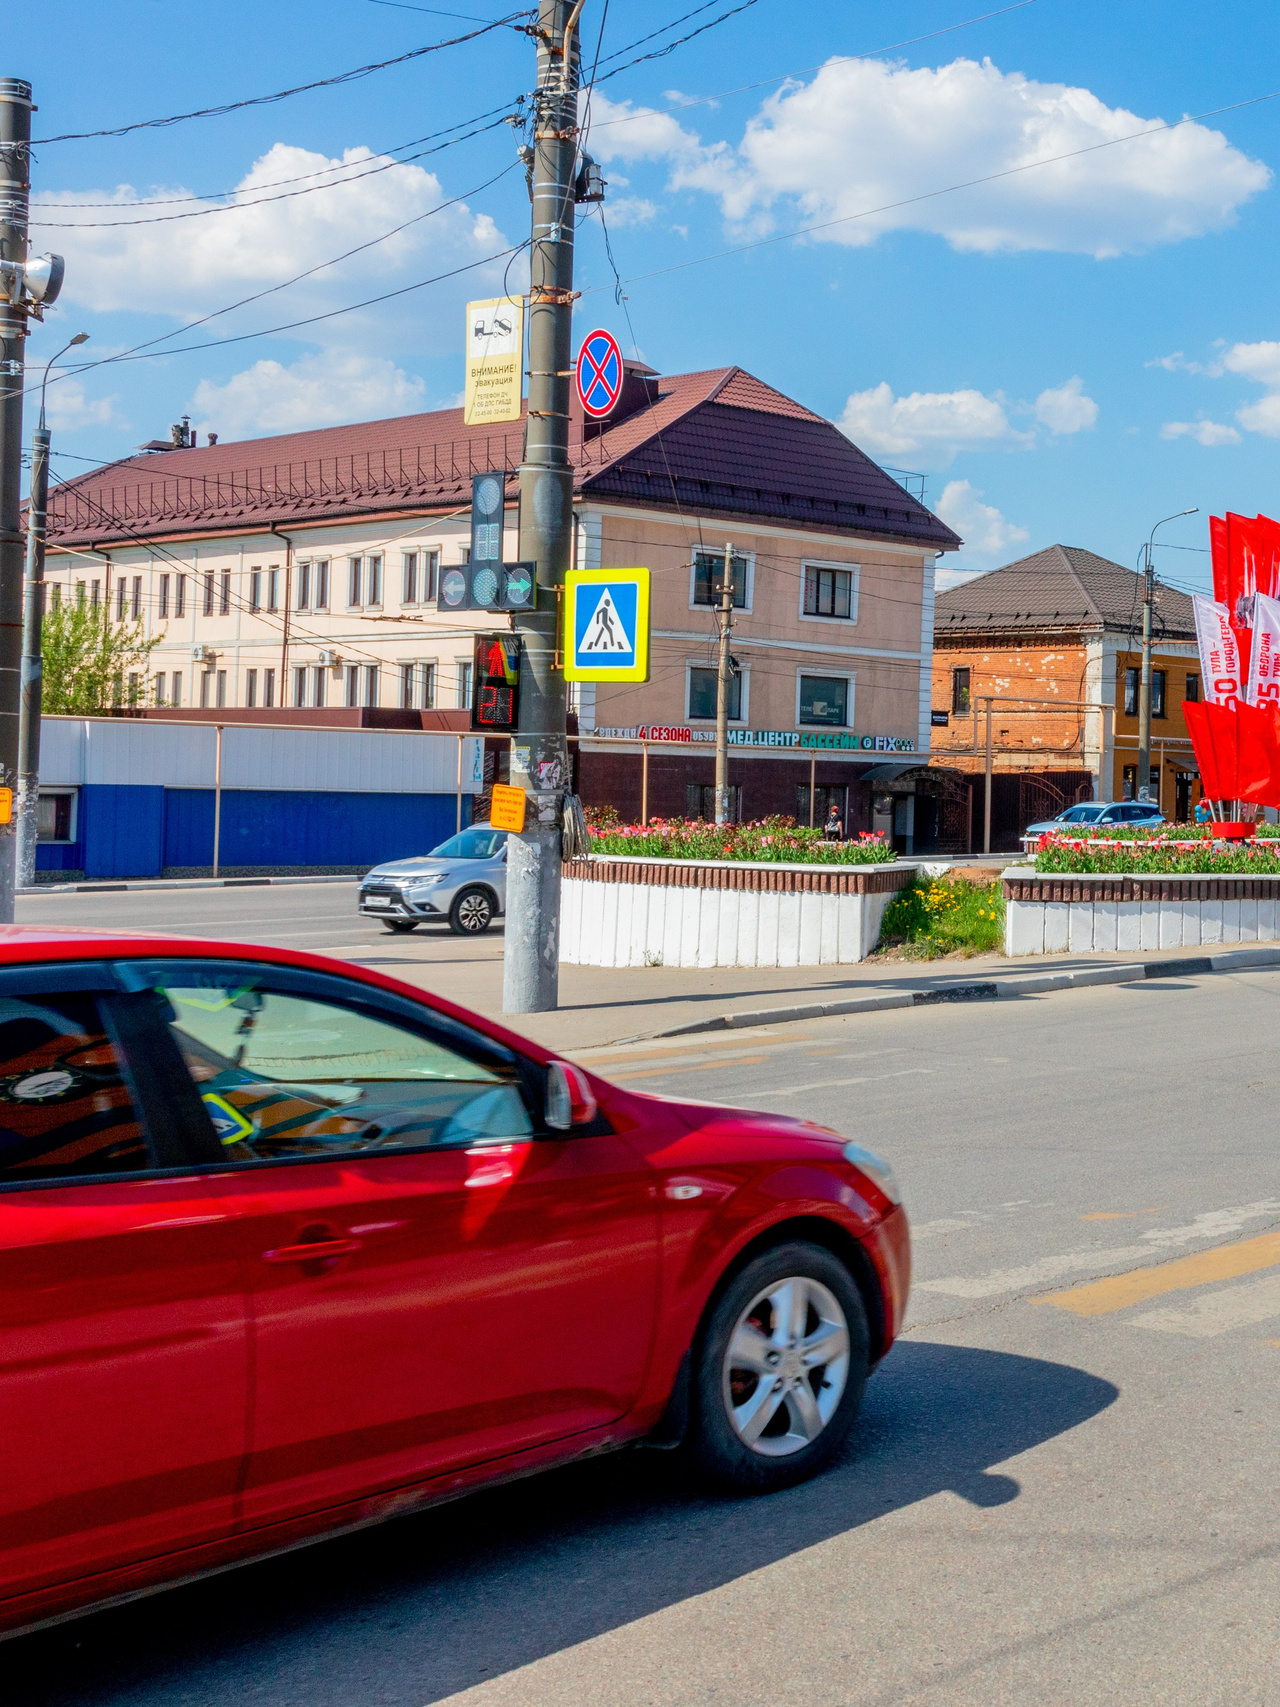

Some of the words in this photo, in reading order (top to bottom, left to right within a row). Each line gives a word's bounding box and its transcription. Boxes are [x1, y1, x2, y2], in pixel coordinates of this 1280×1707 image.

[471, 364, 517, 377] ВНИМАНИЕ!
[1210, 650, 1221, 674] ТУЛА
[1258, 633, 1271, 677] ОБОРОНА
[479, 686, 513, 724] 21
[639, 726, 646, 740] 4
[651, 726, 691, 742] СЕЗОНА
[727, 730, 799, 746] МЕД.ЦЕНТР
[801, 732, 859, 749] БАССЕЙН
